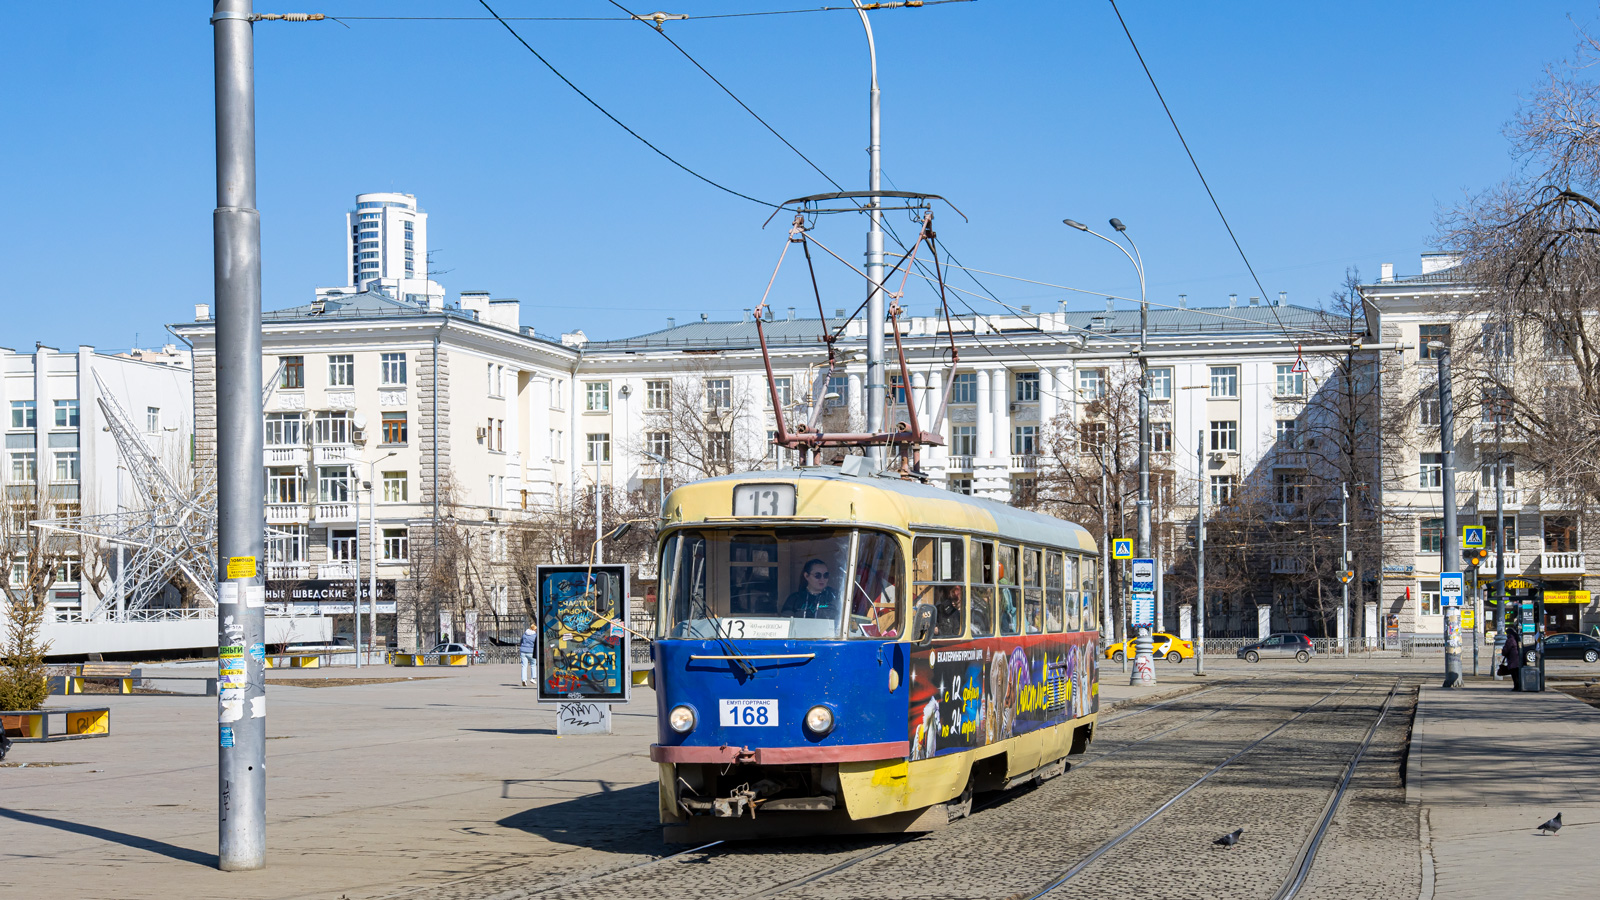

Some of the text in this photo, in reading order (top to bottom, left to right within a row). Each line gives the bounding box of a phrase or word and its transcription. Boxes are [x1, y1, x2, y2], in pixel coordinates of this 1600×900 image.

[749, 490, 779, 517] 13
[265, 590, 285, 598] НЫЕ
[293, 589, 347, 599] ШВЕДСКИЕ
[727, 620, 745, 638] 13
[566, 652, 616, 671] 2021
[952, 675, 962, 701] 12
[76, 714, 108, 733] BUS
[730, 706, 768, 725] 168
[950, 707, 962, 735] 24
